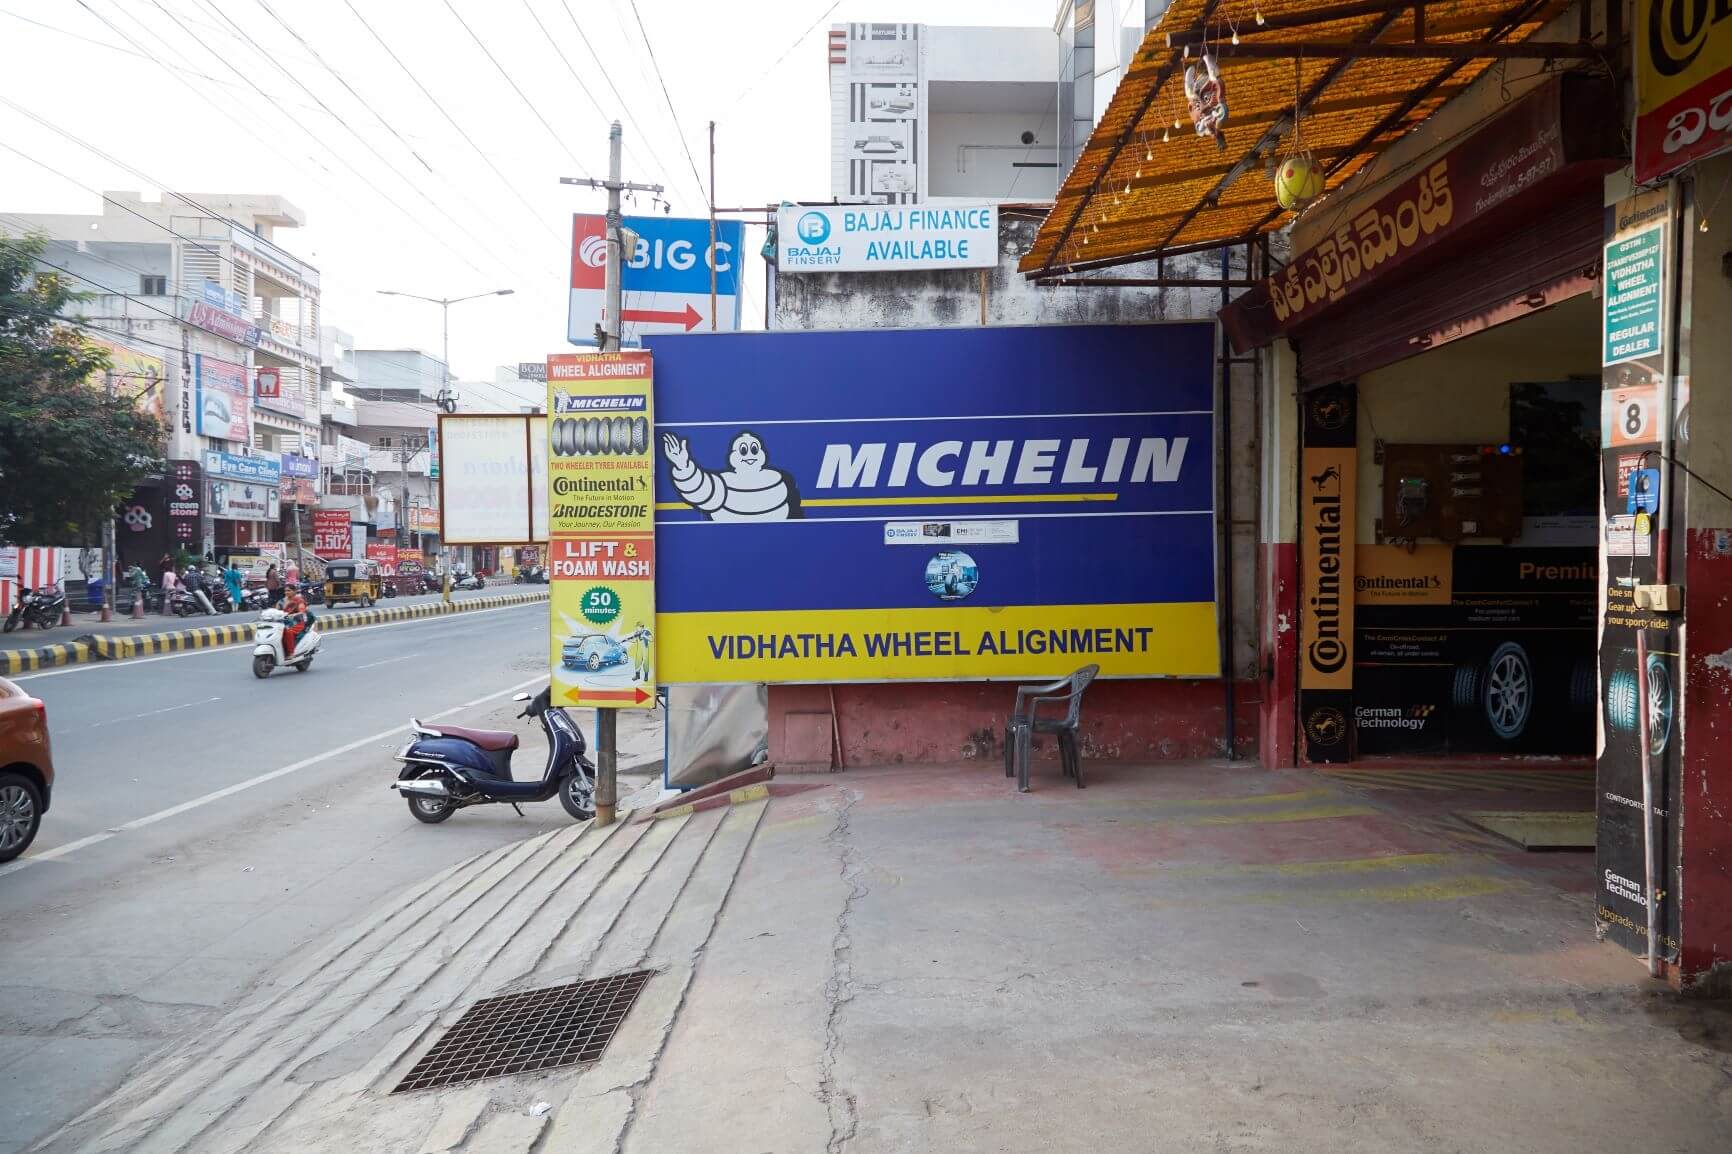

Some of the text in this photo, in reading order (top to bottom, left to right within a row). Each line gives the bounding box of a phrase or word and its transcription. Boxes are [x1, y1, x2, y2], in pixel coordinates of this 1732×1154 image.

[845, 209, 990, 232] BAJAJ FINANCE
[627, 239, 732, 273] BIG C
[788, 247, 841, 256] BAJAJ
[866, 239, 968, 260] AVAILABLE
[788, 257, 841, 265] FINSERV
[1611, 258, 1655, 280] VIDHATHA
[1617, 274, 1647, 291] WHEEL
[1608, 283, 1658, 307] ALIGNMENT
[1609, 321, 1655, 343] REGULAR
[1613, 339, 1650, 356] DEALER
[576, 353, 622, 362] VIDHATHA
[552, 365, 587, 377] WHEEL
[588, 363, 646, 376] ALIGNMENT
[571, 397, 644, 408] MICHELIN
[1626, 403, 1641, 434] 8
[551, 462, 564, 470] TWO
[565, 462, 594, 470] WHEELER
[595, 461, 615, 469] TYRES
[616, 461, 649, 469] AVAILABLE
[815, 437, 1190, 488] MICHELIN
[553, 476, 634, 495] Continental
[553, 504, 648, 518] BRIDGESTONE
[617, 520, 641, 528] Passion
[566, 542, 638, 558] LIFT &
[554, 561, 649, 576] FOAM WASH
[1308, 495, 1347, 674] Continental
[1355, 575, 1428, 592] Continental
[590, 592, 611, 605] 50
[1608, 587, 1623, 597] One
[1608, 601, 1624, 611] Gear
[1608, 617, 1669, 629] your sporty ride!
[708, 627, 1153, 659] VIDHATHA WHEEL ALIGNMENT
[1355, 706, 1402, 718] German
[1355, 717, 1425, 729] Technology
[1605, 868, 1641, 892] German
[1598, 904, 1634, 929] Upgrade
